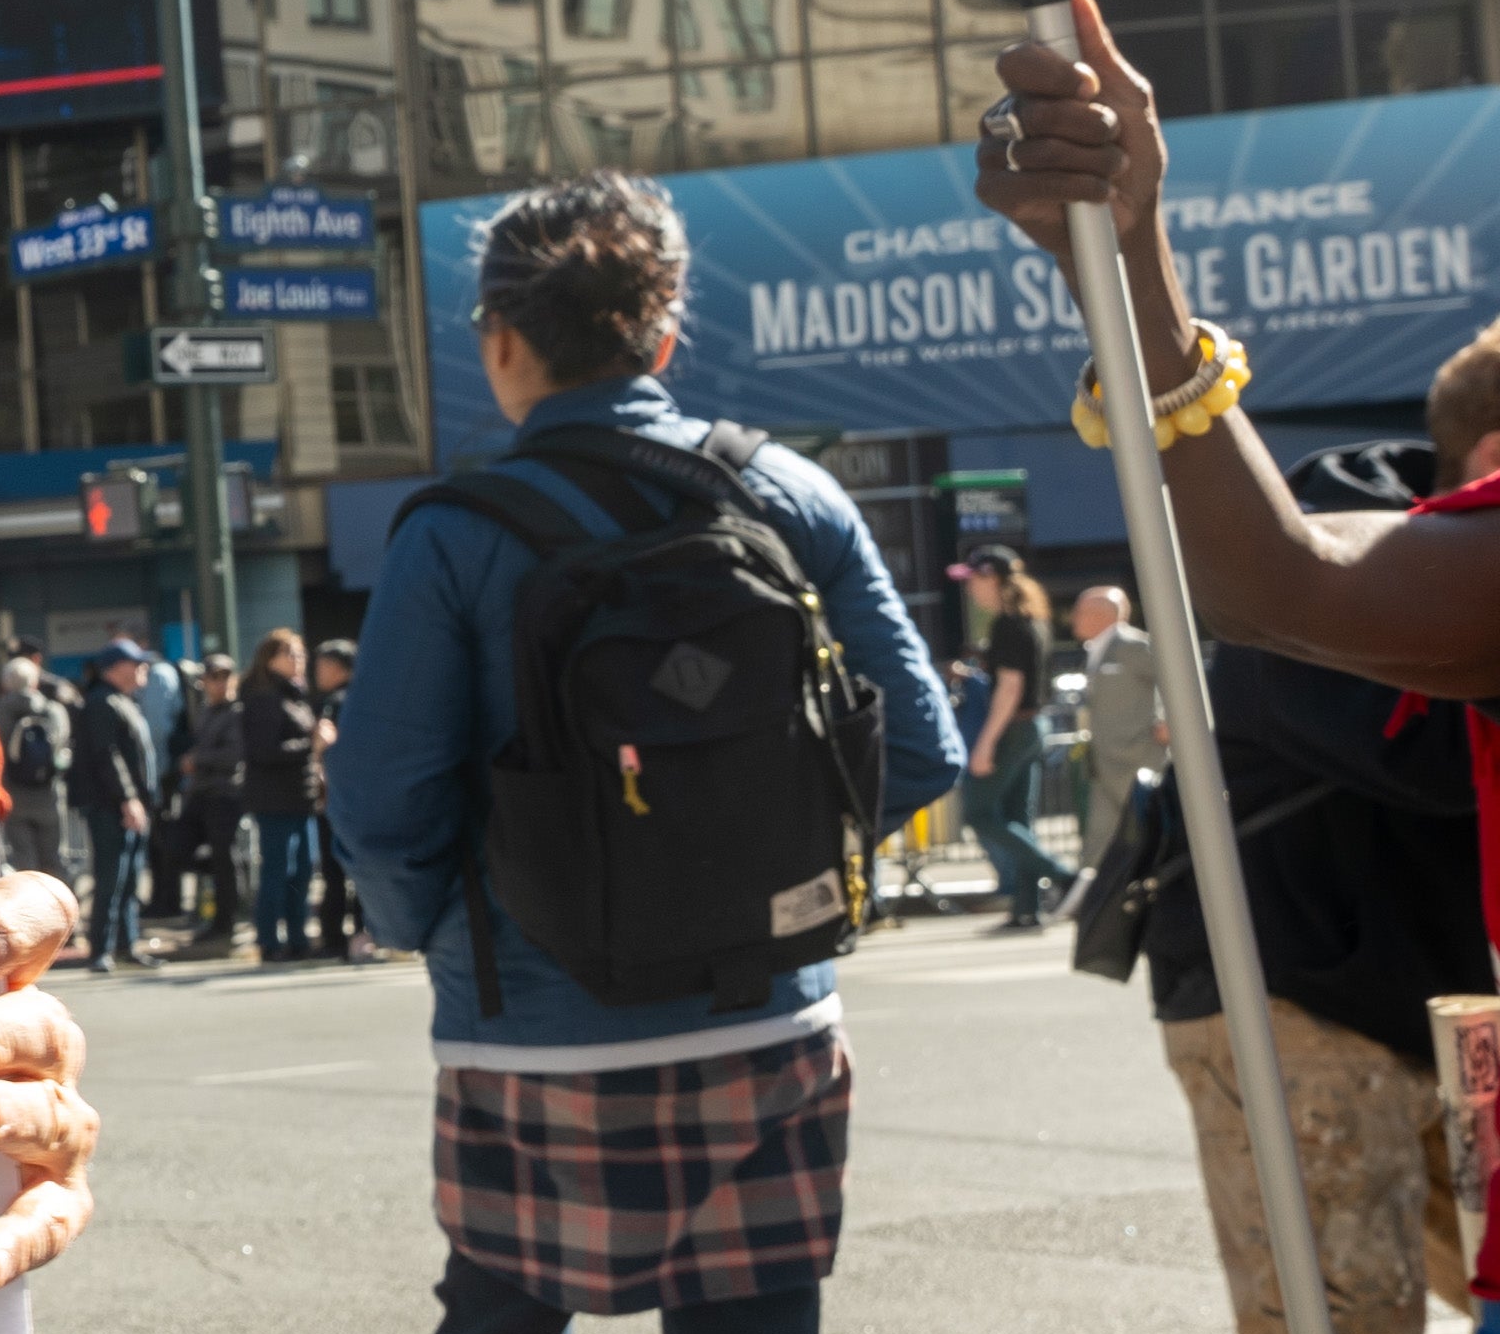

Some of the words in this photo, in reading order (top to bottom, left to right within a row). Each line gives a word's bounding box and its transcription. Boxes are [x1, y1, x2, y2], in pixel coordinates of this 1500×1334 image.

[17, 233, 77, 270] West
[120, 214, 149, 251] St
[230, 203, 311, 245] Eighth
[313, 205, 363, 239] Ave
[843, 215, 1000, 264] CHASE
[236, 277, 272, 311] Joe
[275, 276, 331, 311] Louis
[750, 269, 997, 355] MADISON
[1243, 224, 1474, 312] GARDEN
